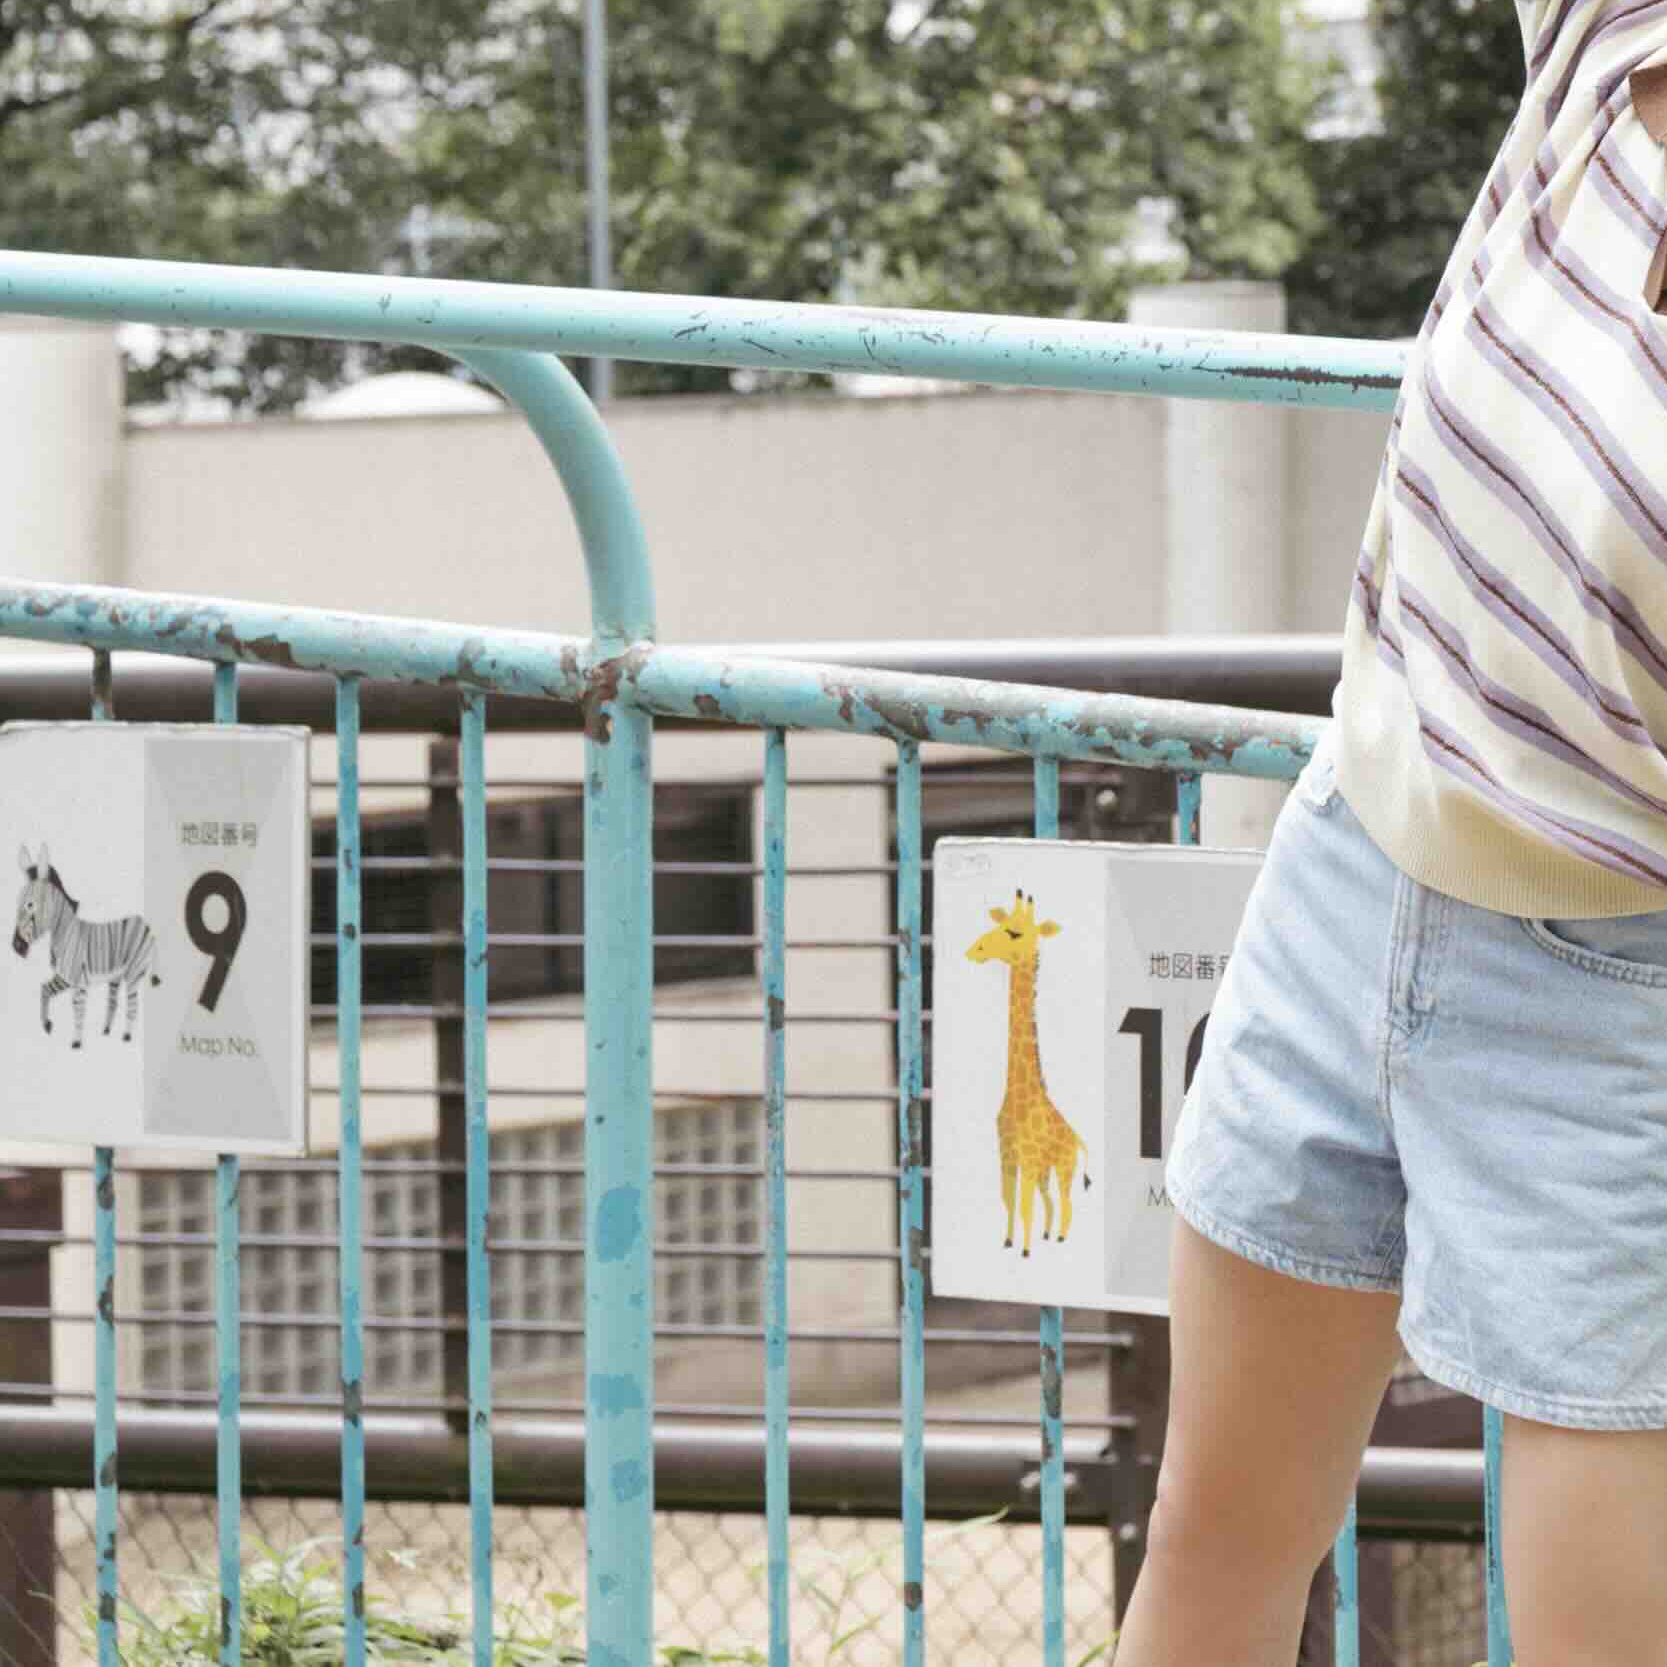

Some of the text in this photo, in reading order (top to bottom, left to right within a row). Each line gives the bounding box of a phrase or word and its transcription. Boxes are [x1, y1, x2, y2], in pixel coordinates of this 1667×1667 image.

[181, 821, 258, 847] 地図番号
[185, 871, 247, 1013] 9
[180, 1036, 223, 1058] Map
